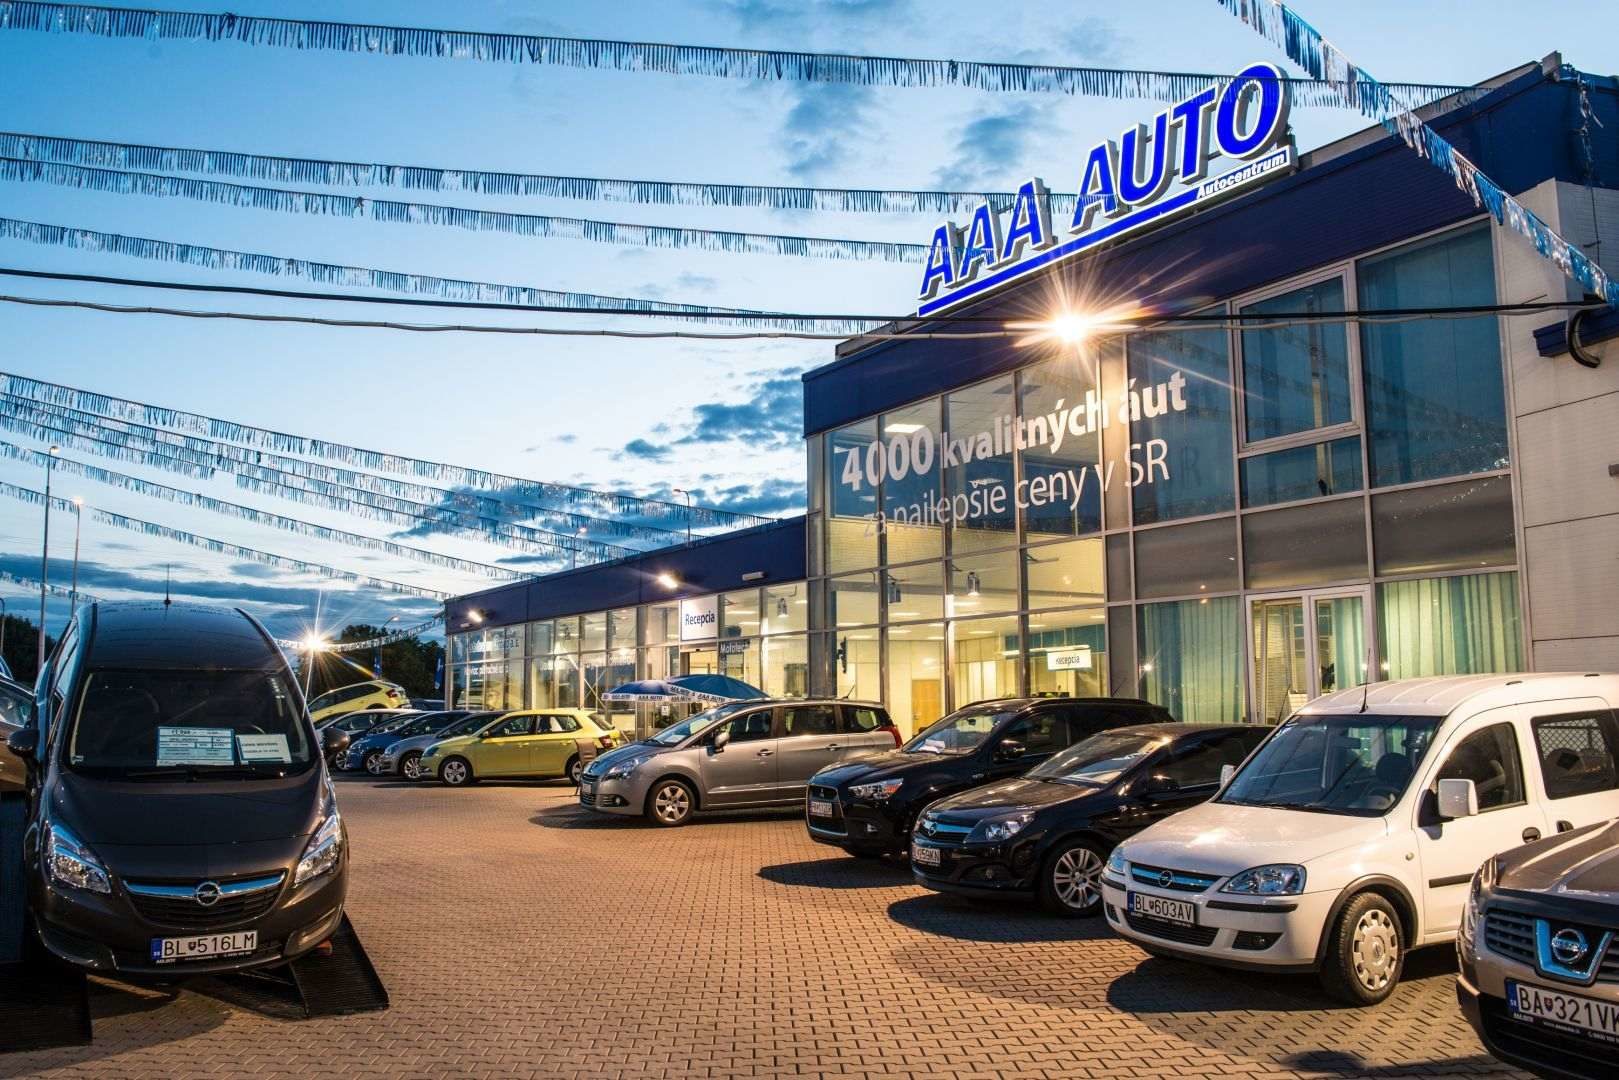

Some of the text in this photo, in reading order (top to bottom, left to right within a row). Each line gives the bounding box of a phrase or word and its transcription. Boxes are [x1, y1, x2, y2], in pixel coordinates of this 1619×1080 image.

[918, 61, 1284, 299] AAA AUTO
[1195, 152, 1286, 201] Autocentrum
[841, 370, 1188, 492] 4000 kvalitných áut
[863, 508, 887, 539] za
[893, 478, 1007, 532] najlepšie
[1016, 465, 1088, 512] ceny
[1124, 437, 1171, 488] SR
[685, 610, 716, 629] Recepcia
[1135, 894, 1149, 912] BL
[1154, 899, 1193, 921] 603AV
[164, 940, 187, 957] BL
[197, 933, 255, 954] 516LM
[1519, 987, 1544, 1016] BA
[1554, 996, 1619, 1033] 321VK
